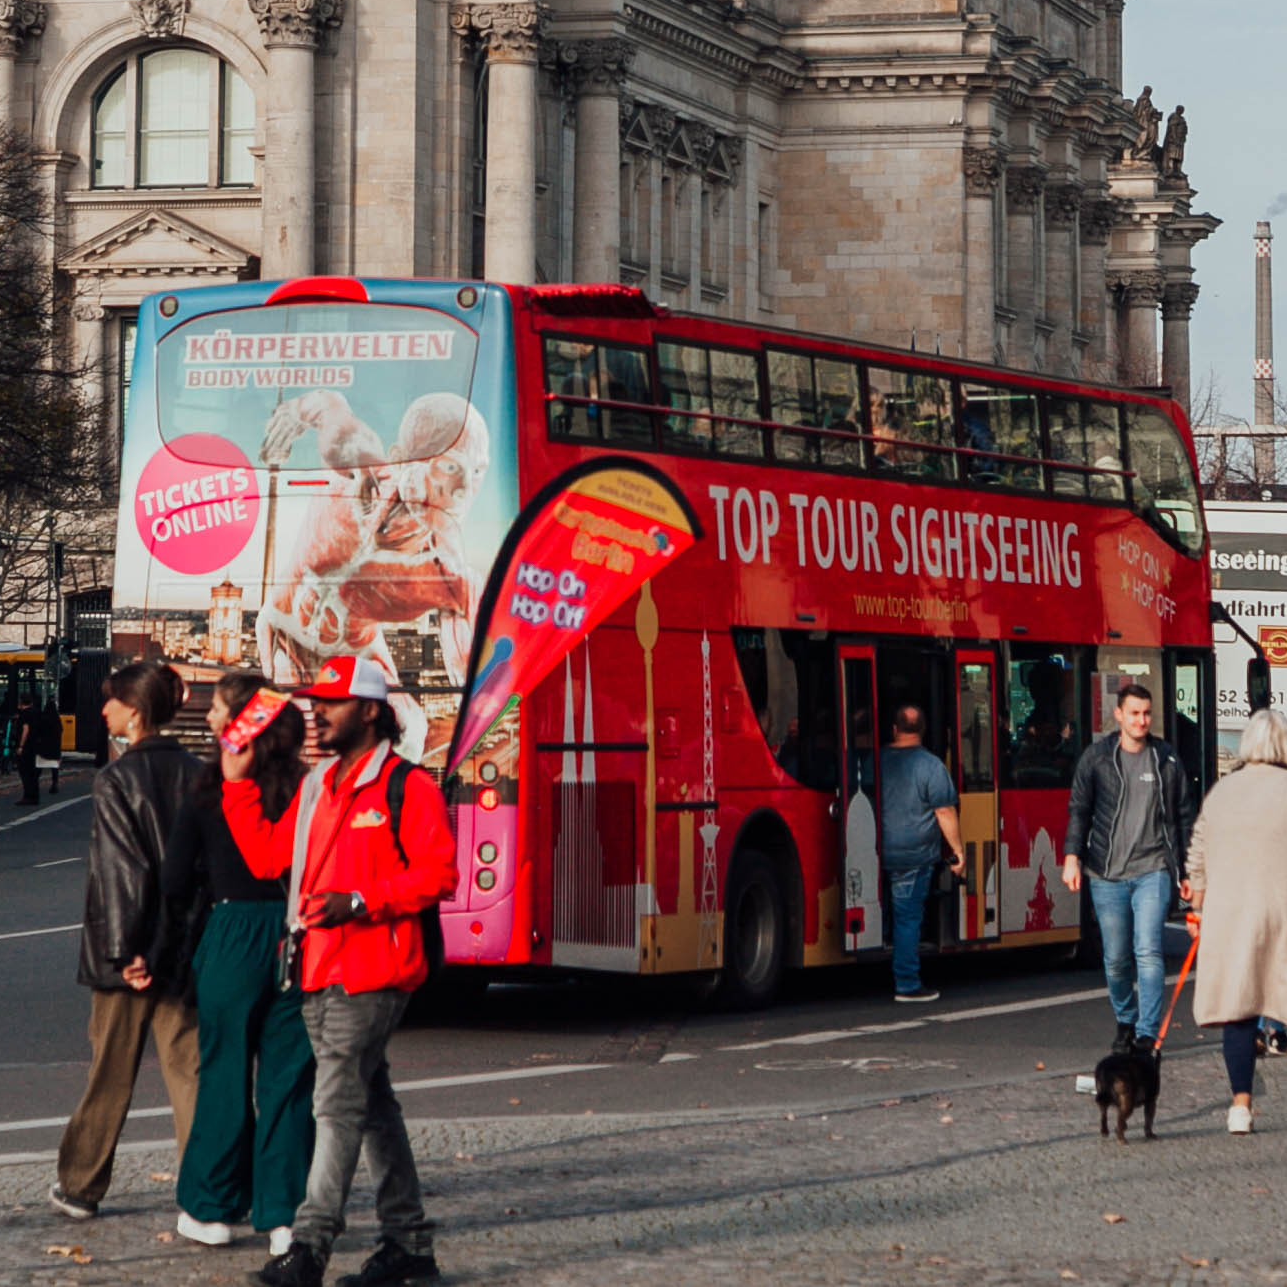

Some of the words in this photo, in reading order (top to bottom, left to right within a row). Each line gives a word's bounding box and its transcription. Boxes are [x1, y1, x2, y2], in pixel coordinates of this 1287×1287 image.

[188, 331, 452, 361] KÖRPERWELTEN
[188, 369, 251, 387] BODY
[255, 368, 352, 386] WORLDS
[138, 467, 249, 517] TICKETS
[151, 498, 248, 542] ONLINE
[708, 485, 780, 564] TOP
[789, 493, 883, 573] TOUR
[890, 502, 1082, 588] SIGHTSEEING
[1118, 533, 1141, 567] HOP
[1141, 551, 1160, 582] ON
[516, 562, 554, 593] Hop
[558, 569, 586, 599] On
[511, 593, 549, 625] Hop
[553, 600, 586, 630] Off
[853, 593, 969, 624] www.top-tour.berlin
[1132, 576, 1154, 609] HOP
[1156, 593, 1177, 625] OFF
[1218, 689, 1238, 703] 52
